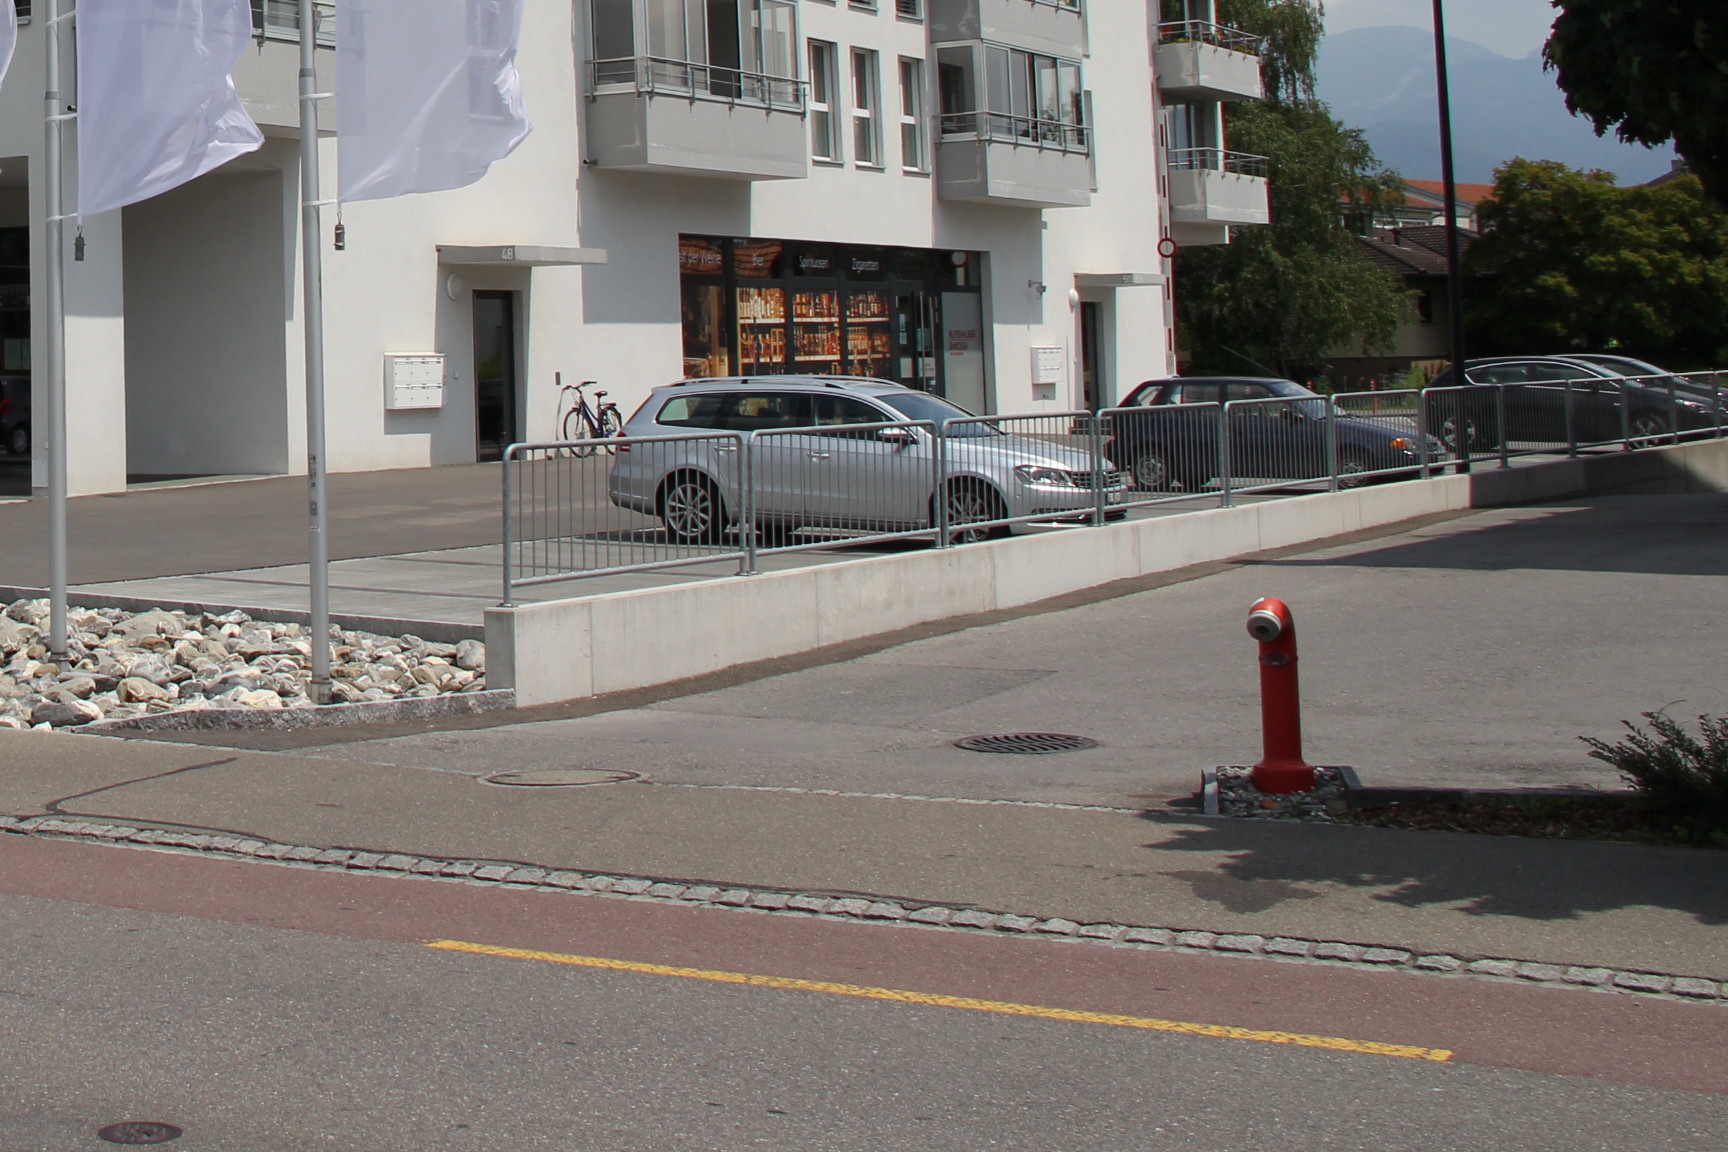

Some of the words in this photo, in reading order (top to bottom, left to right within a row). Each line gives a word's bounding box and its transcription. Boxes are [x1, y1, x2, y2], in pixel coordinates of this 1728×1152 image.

[501, 247, 513, 260] 48
[700, 250, 723, 264] Weine
[799, 255, 829, 270] Spirituosen
[852, 257, 879, 273] Zigaretten
